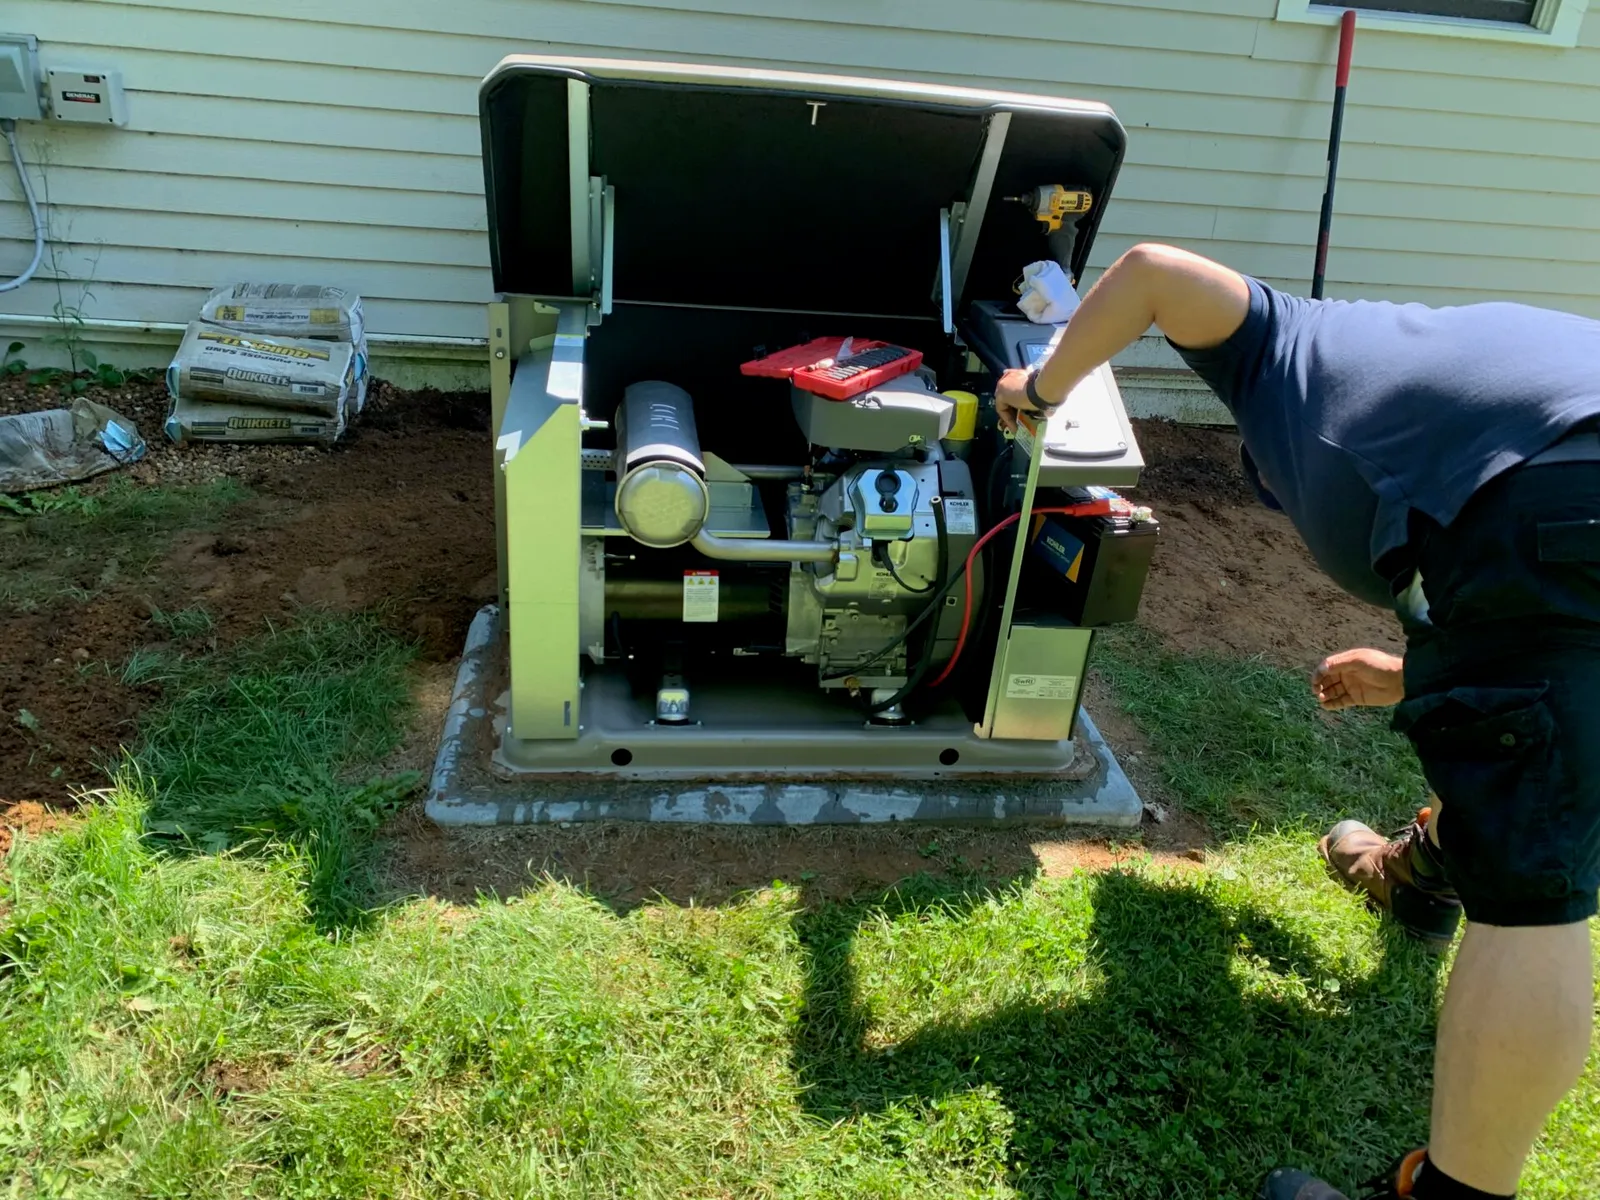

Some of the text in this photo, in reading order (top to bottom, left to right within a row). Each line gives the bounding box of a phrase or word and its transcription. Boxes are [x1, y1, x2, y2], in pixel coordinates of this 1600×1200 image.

[227, 367, 291, 386] QUIKRETE
[228, 417, 291, 430] QUIKRETE
[1046, 536, 1066, 555] KOHLER
